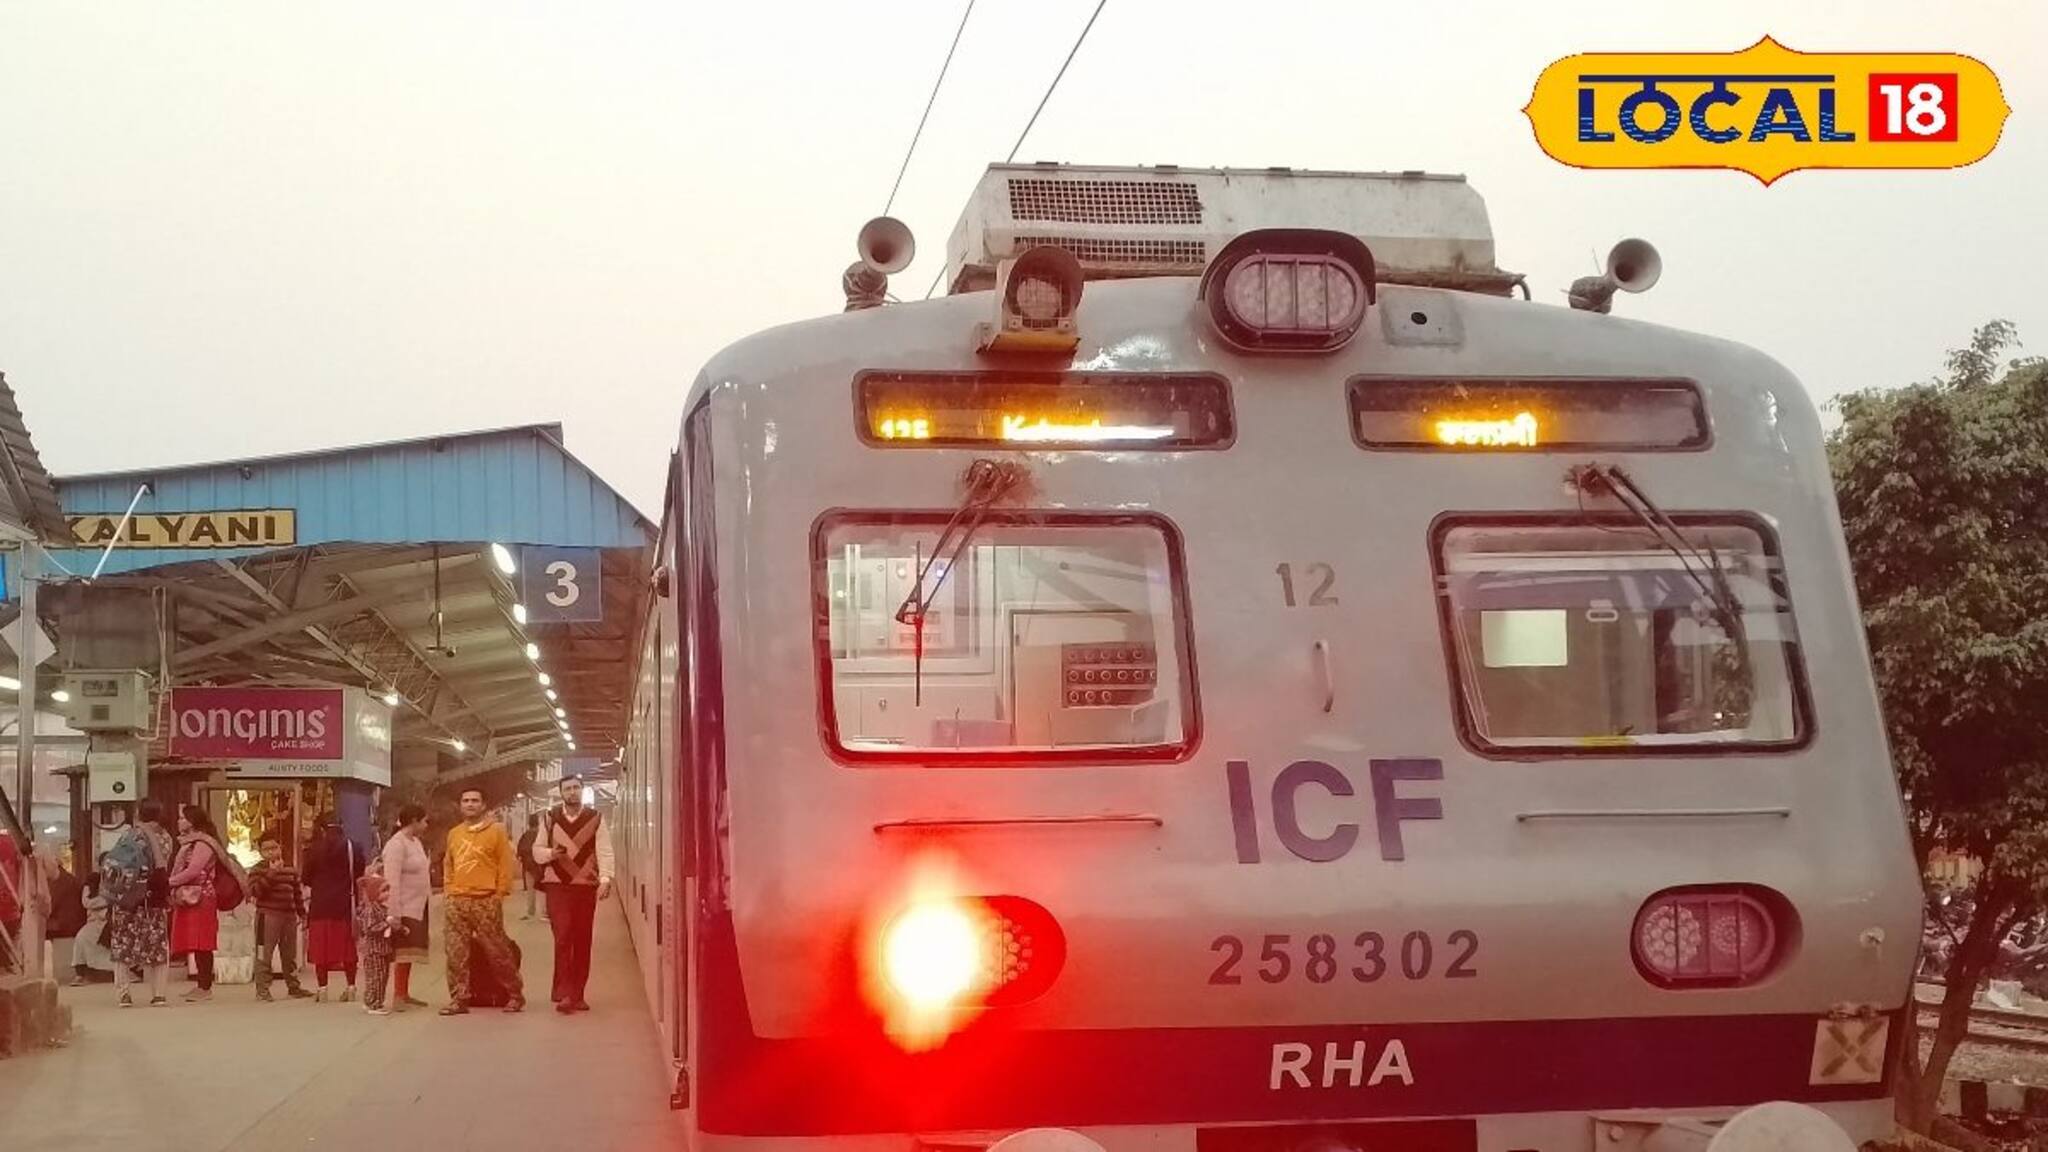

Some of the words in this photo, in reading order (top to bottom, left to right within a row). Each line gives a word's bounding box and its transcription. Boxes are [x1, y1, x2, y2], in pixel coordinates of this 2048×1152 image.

[545, 560, 580, 607] 3
[1276, 563, 1339, 606] 12
[271, 740, 298, 750] CAKE
[1226, 758, 1444, 864] ICF
[1207, 929, 1480, 985] 258302
[1270, 1039, 1414, 1089] RHA
